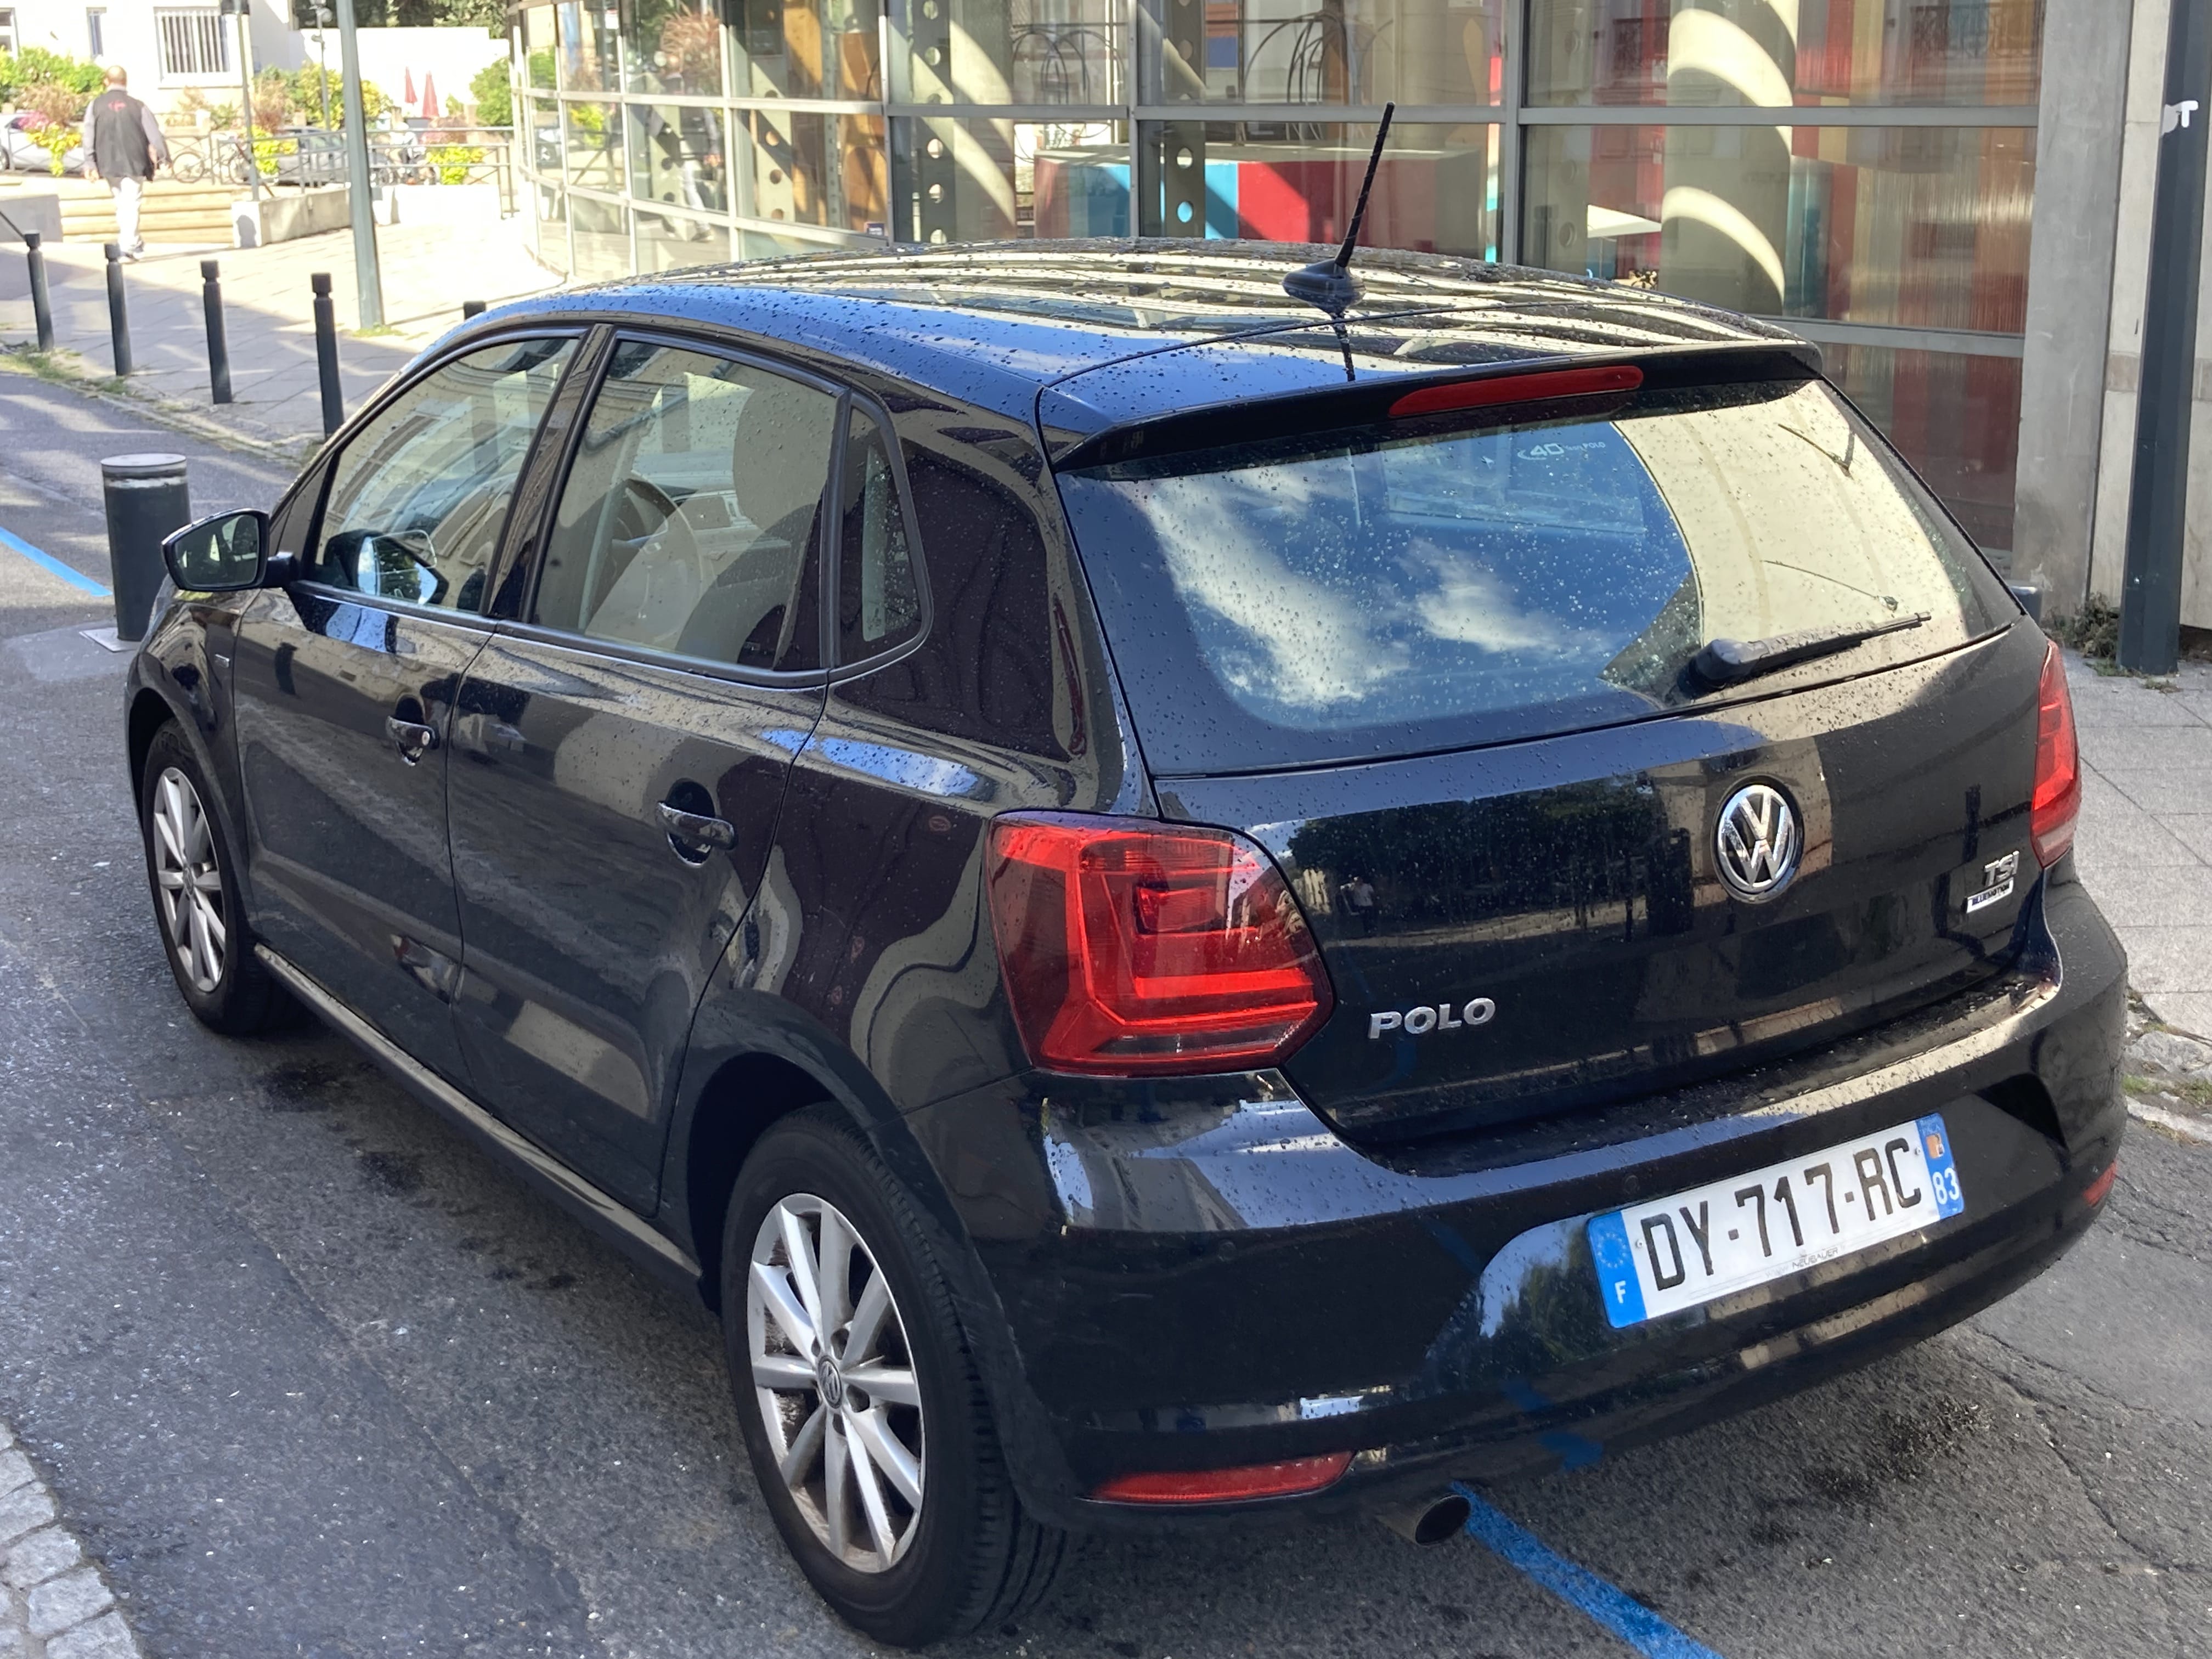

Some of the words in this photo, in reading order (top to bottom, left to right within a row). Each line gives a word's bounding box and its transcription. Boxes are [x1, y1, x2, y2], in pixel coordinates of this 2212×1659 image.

[1530, 443, 1564, 456] 40
[1984, 850, 2019, 888] TSI
[1368, 997, 1496, 1039] POLO
[1932, 1167, 1960, 1204] 83
[1641, 1137, 1921, 1291] DY-717-RC
[1615, 1280, 1626, 1304] F
